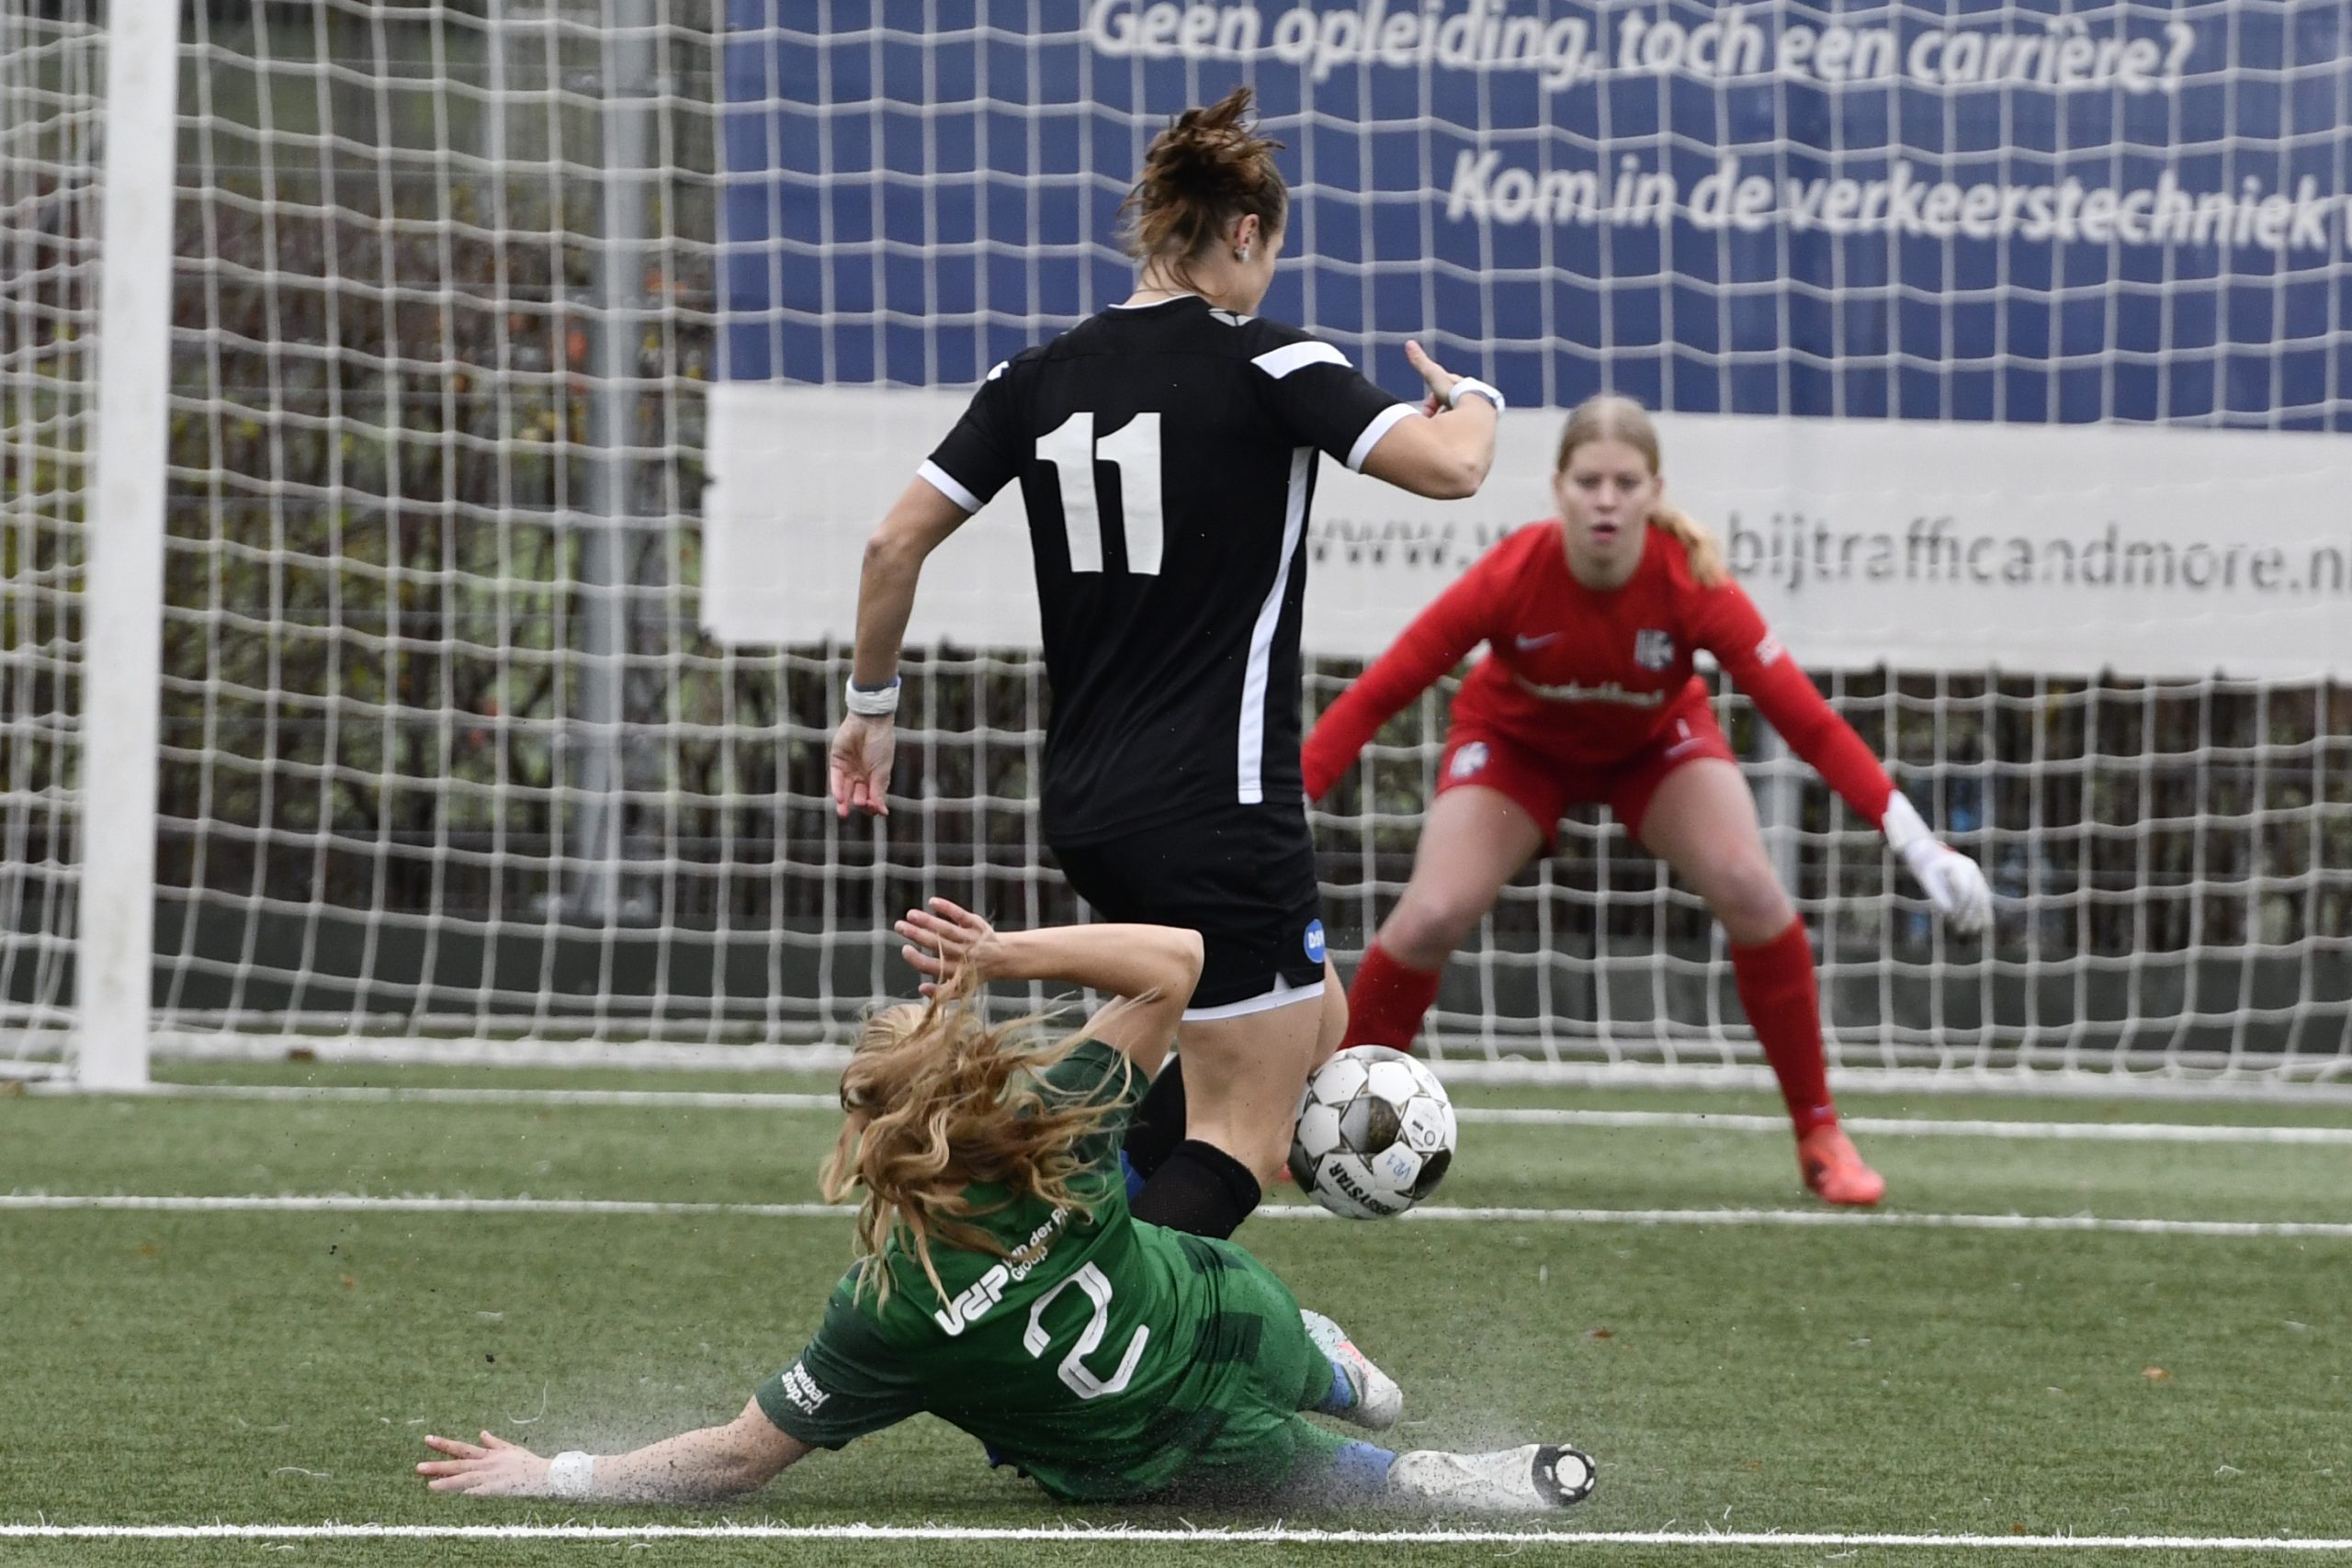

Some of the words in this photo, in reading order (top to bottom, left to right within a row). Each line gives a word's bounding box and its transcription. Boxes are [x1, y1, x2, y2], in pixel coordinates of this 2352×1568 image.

[1088, 0, 1261, 61] Geen
[1273, 0, 1598, 90] opleiding,
[1618, 5, 1763, 76] toch
[1777, 22, 1895, 82] een
[1908, 17, 2197, 92] carrière?
[1446, 151, 1600, 223] Kom
[1612, 154, 1675, 226] in
[1689, 153, 1777, 231] de
[1786, 162, 2328, 251] verkeerstechniek
[1035, 412, 1164, 576] 11
[1011, 1246, 1048, 1282] Group
[1029, 1221, 1054, 1247] der
[1023, 1260, 1150, 1400] 2
